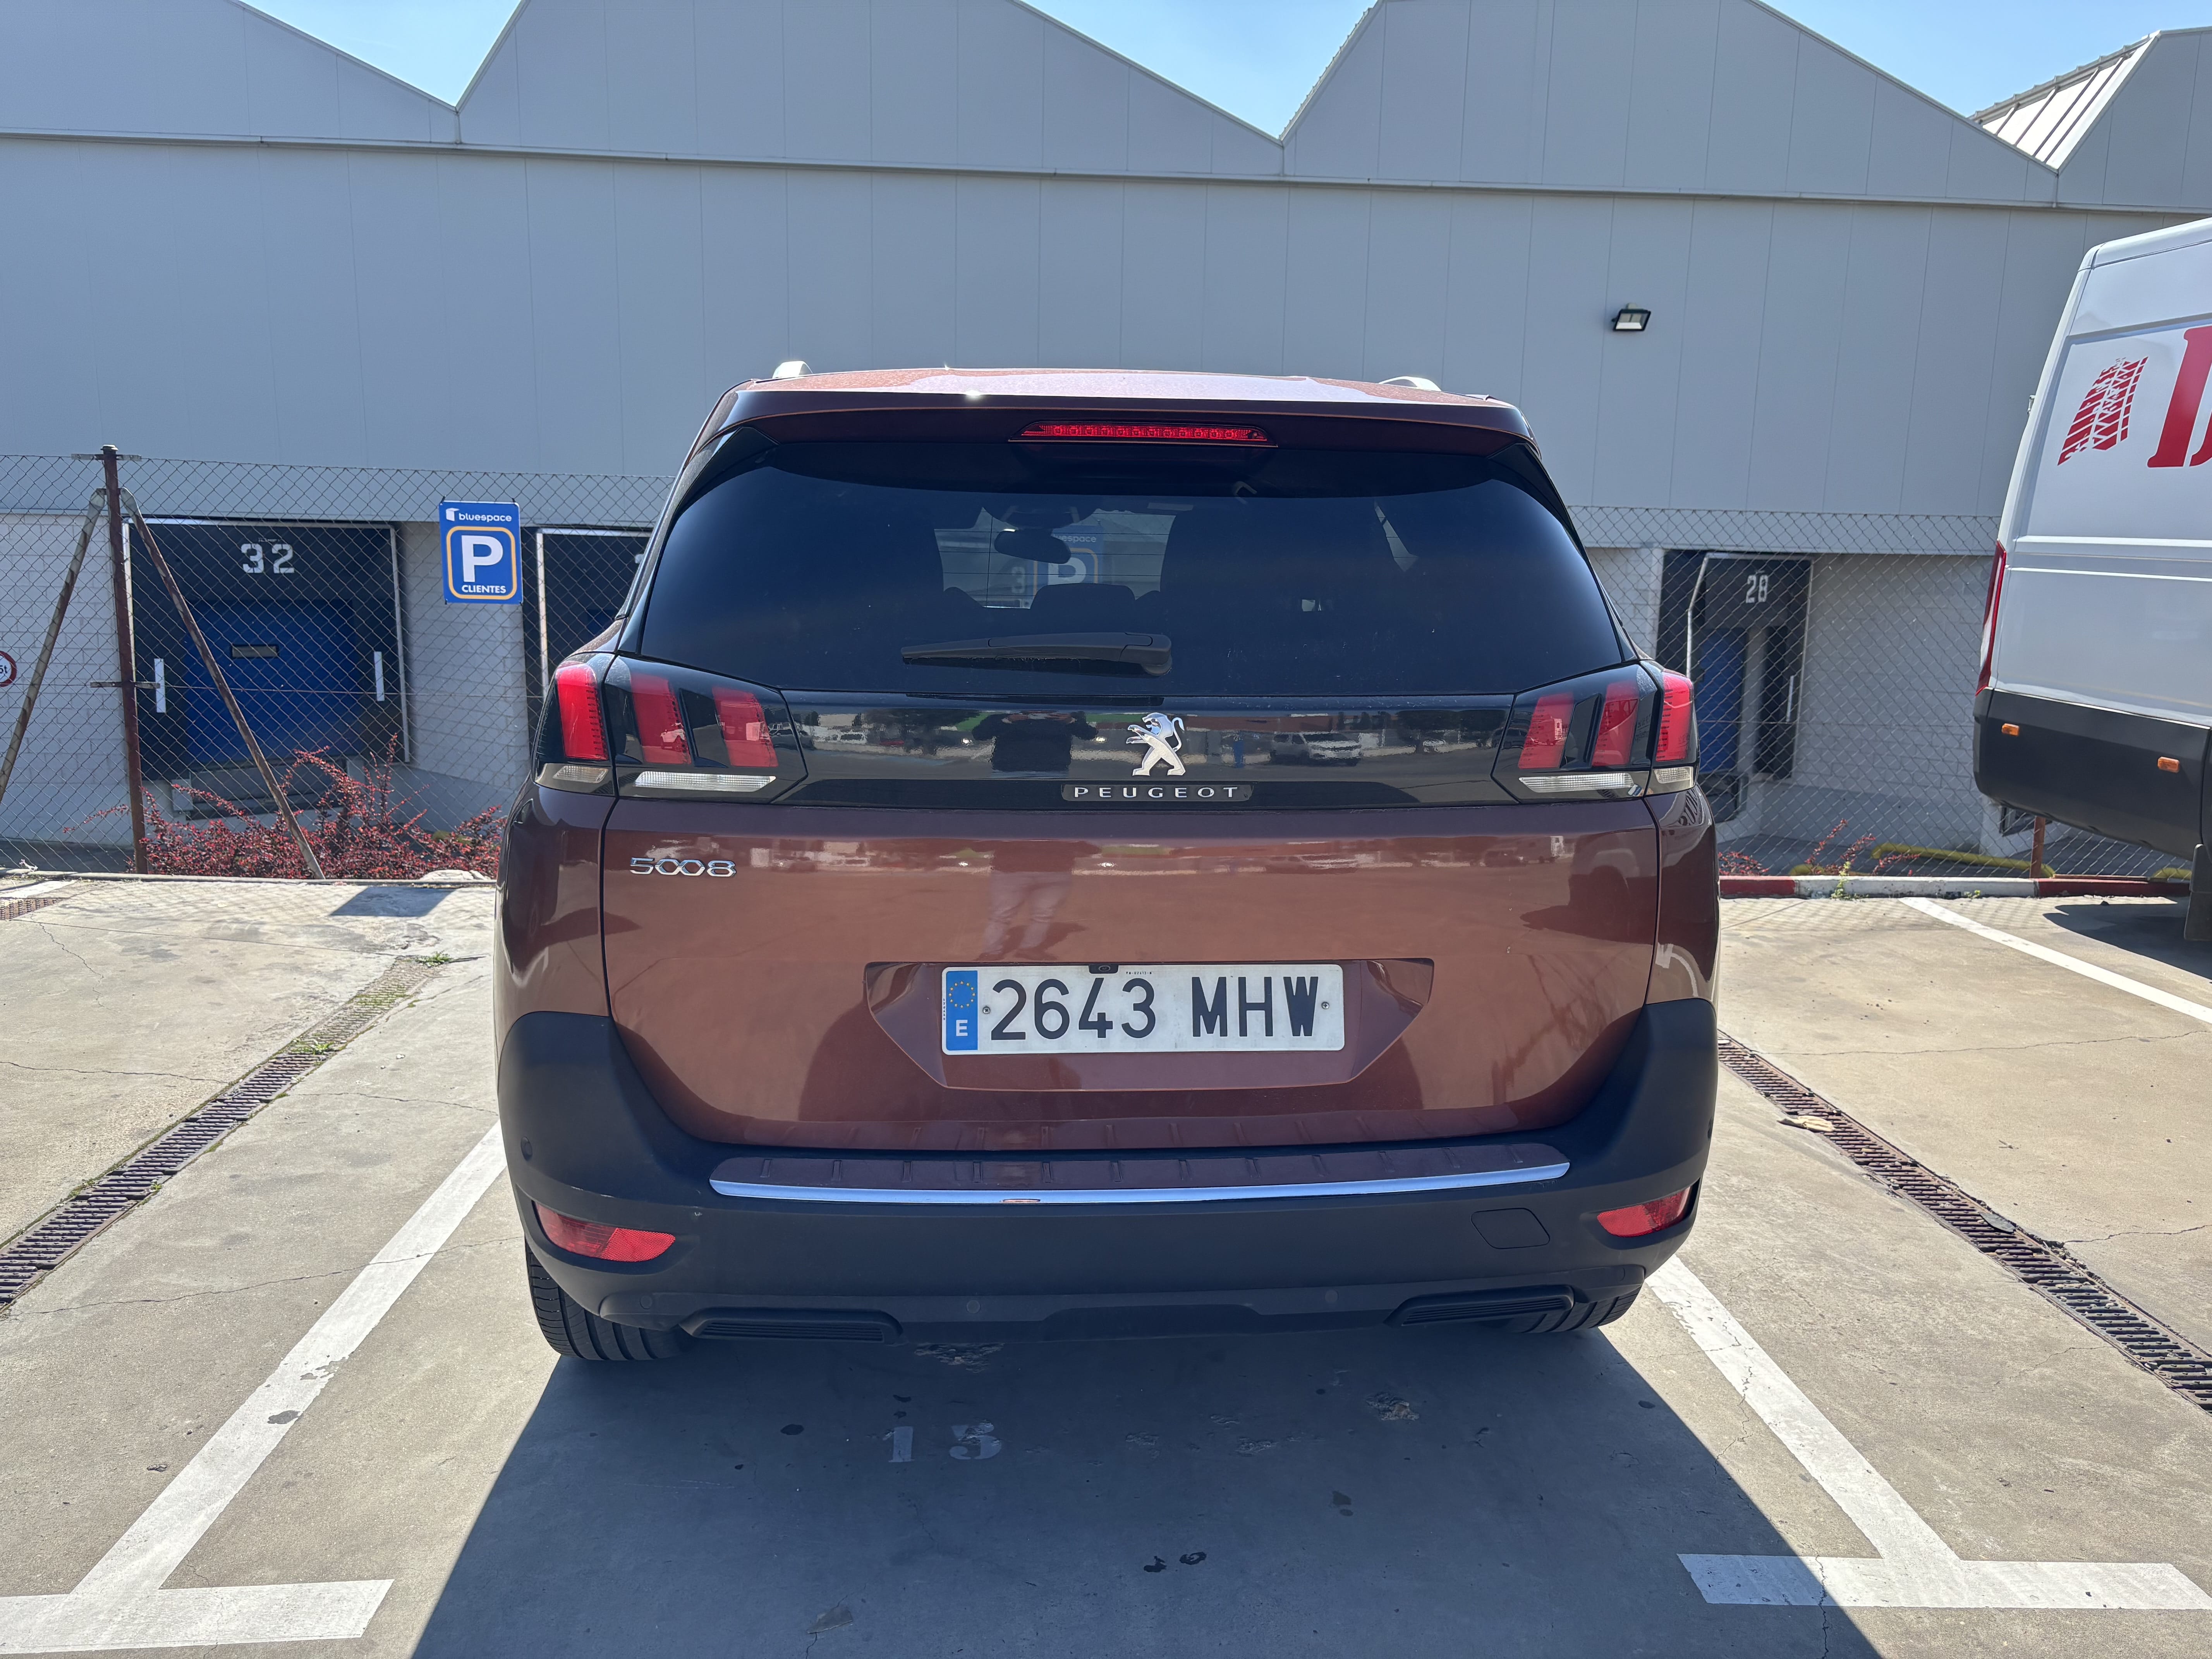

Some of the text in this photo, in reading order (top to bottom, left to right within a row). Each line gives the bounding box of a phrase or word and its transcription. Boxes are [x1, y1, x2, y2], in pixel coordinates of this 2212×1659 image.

[459, 513, 512, 522] bluespace
[1054, 534, 1097, 543] uespace
[241, 543, 294, 574] 32
[462, 535, 503, 582] P
[462, 585, 506, 593] CLIENTES
[1746, 575, 1769, 603] 28
[1074, 787, 1238, 798] PEUGEOT
[630, 857, 737, 877] 5008
[956, 977, 1318, 1041] E 2643 MHW
